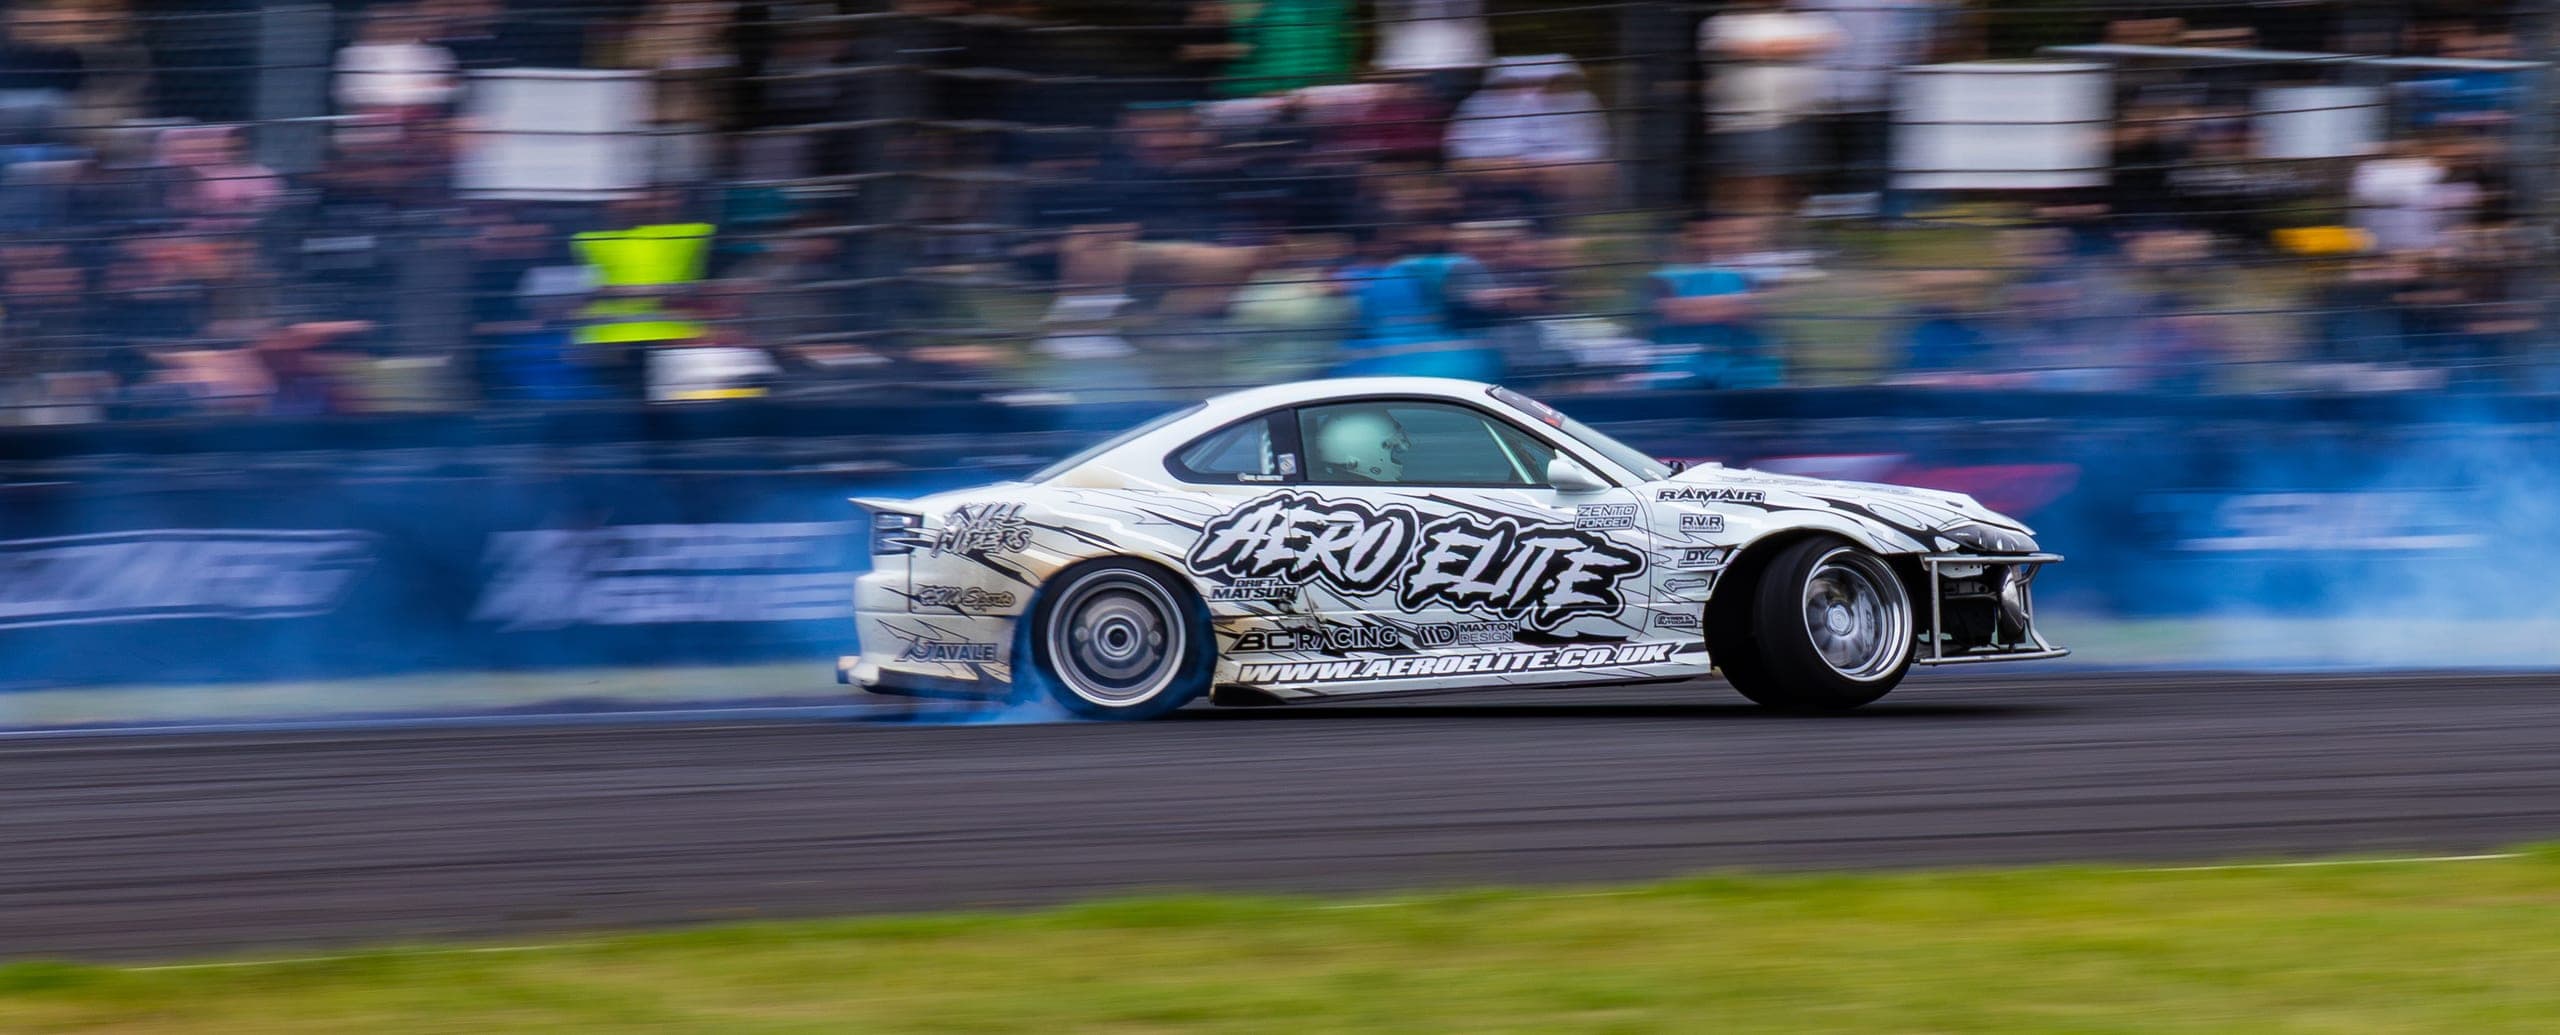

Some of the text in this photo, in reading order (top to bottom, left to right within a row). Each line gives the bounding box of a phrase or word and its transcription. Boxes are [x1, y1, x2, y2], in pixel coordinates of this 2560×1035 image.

[1659, 485, 1763, 504] RAMAIR
[1577, 517, 1632, 530] FORGED
[1194, 500, 1631, 619] AERO ELITE
[1235, 578, 1277, 588] DRIFT
[1211, 586, 1298, 600] MATSURI
[1460, 622, 1519, 632] MAXTON
[1460, 631, 1513, 642] DESIGN
[1238, 644, 1671, 682] WWW.AEROELITE.CO.UK
